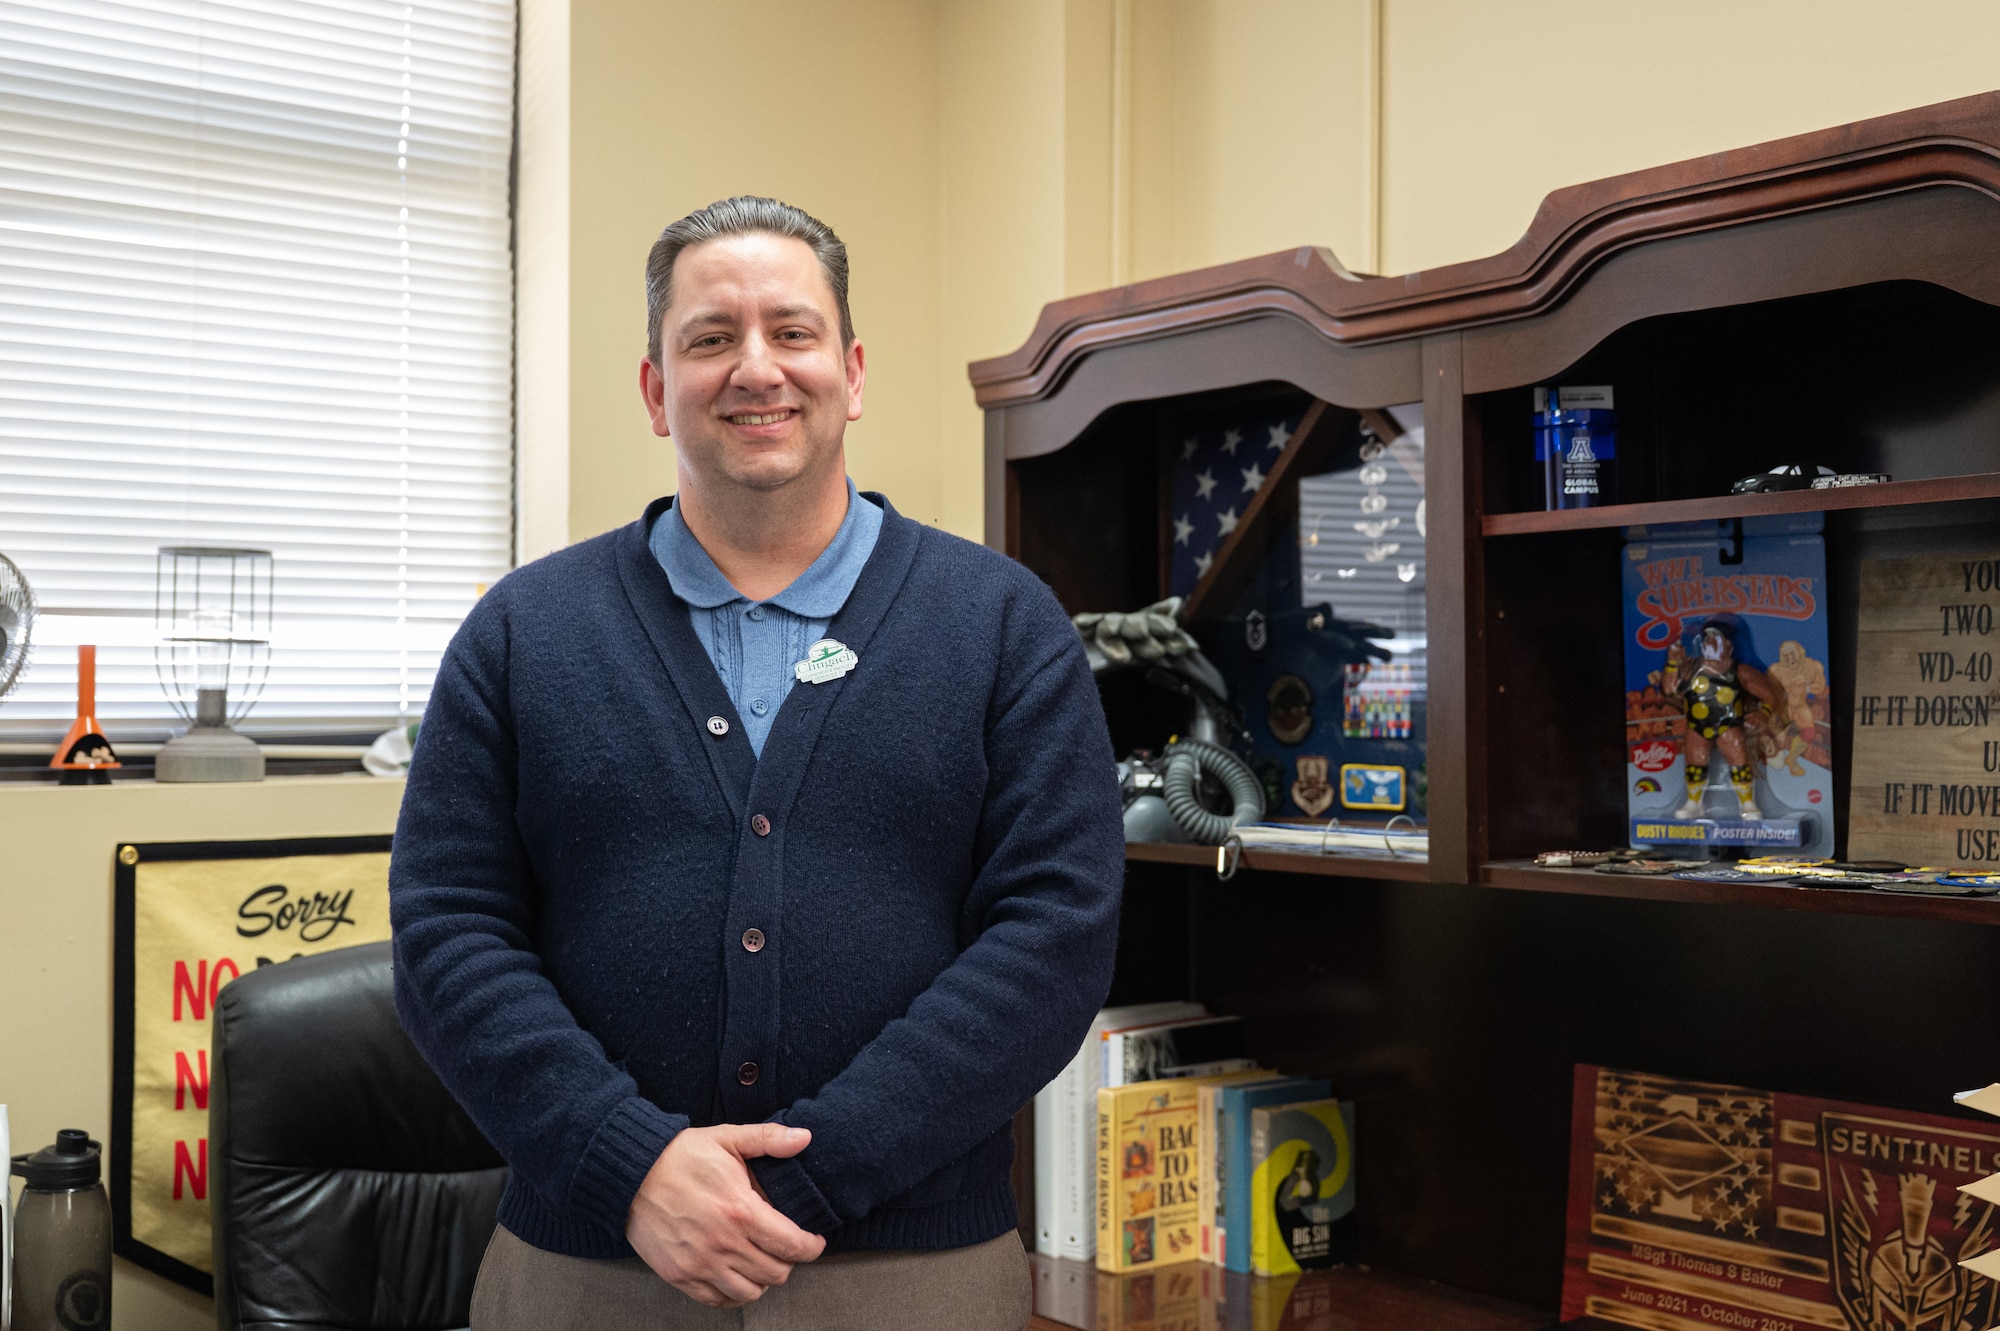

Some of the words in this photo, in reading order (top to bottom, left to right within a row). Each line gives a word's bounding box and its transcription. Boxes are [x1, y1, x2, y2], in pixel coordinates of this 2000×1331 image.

[1564, 487, 1599, 495] CAMPUS
[1565, 479, 1597, 487] GLOBAL
[1636, 556, 1704, 586] WWE
[1636, 574, 1816, 650] SUPERSTARS
[1940, 604, 1993, 636] TWO
[798, 652, 855, 674] Chugach
[1918, 651, 1992, 683] WD-40
[1860, 695, 1881, 726] IF
[1887, 695, 1908, 726] IT
[1914, 695, 2000, 727] DOESN'
[1984, 740, 2000, 772] U
[1884, 783, 1905, 814] IF
[1911, 783, 1933, 815] IT
[1636, 824, 1667, 839] DUSTY
[1713, 826, 1754, 840] POSTER
[1756, 827, 1796, 841] INSIDE!
[1957, 828, 2000, 862] USE
[237, 885, 355, 942] Sorry
[174, 1050, 210, 1111] N
[1159, 1122, 1198, 1151] BAC
[173, 1138, 208, 1201] N
[1159, 1153, 1189, 1179] TO
[1159, 1178, 1198, 1207] BAS
[1292, 1227, 1311, 1246] BIG
[1312, 1224, 1330, 1242] SIN
[1632, 1244, 1666, 1265] MSgt
[1670, 1252, 1724, 1276] Thomas
[1727, 1264, 1738, 1279] S
[1741, 1268, 1784, 1289] Baker
[1621, 1286, 1653, 1304] June
[1657, 1294, 1688, 1313] 2021
[1700, 1304, 1757, 1329] October
